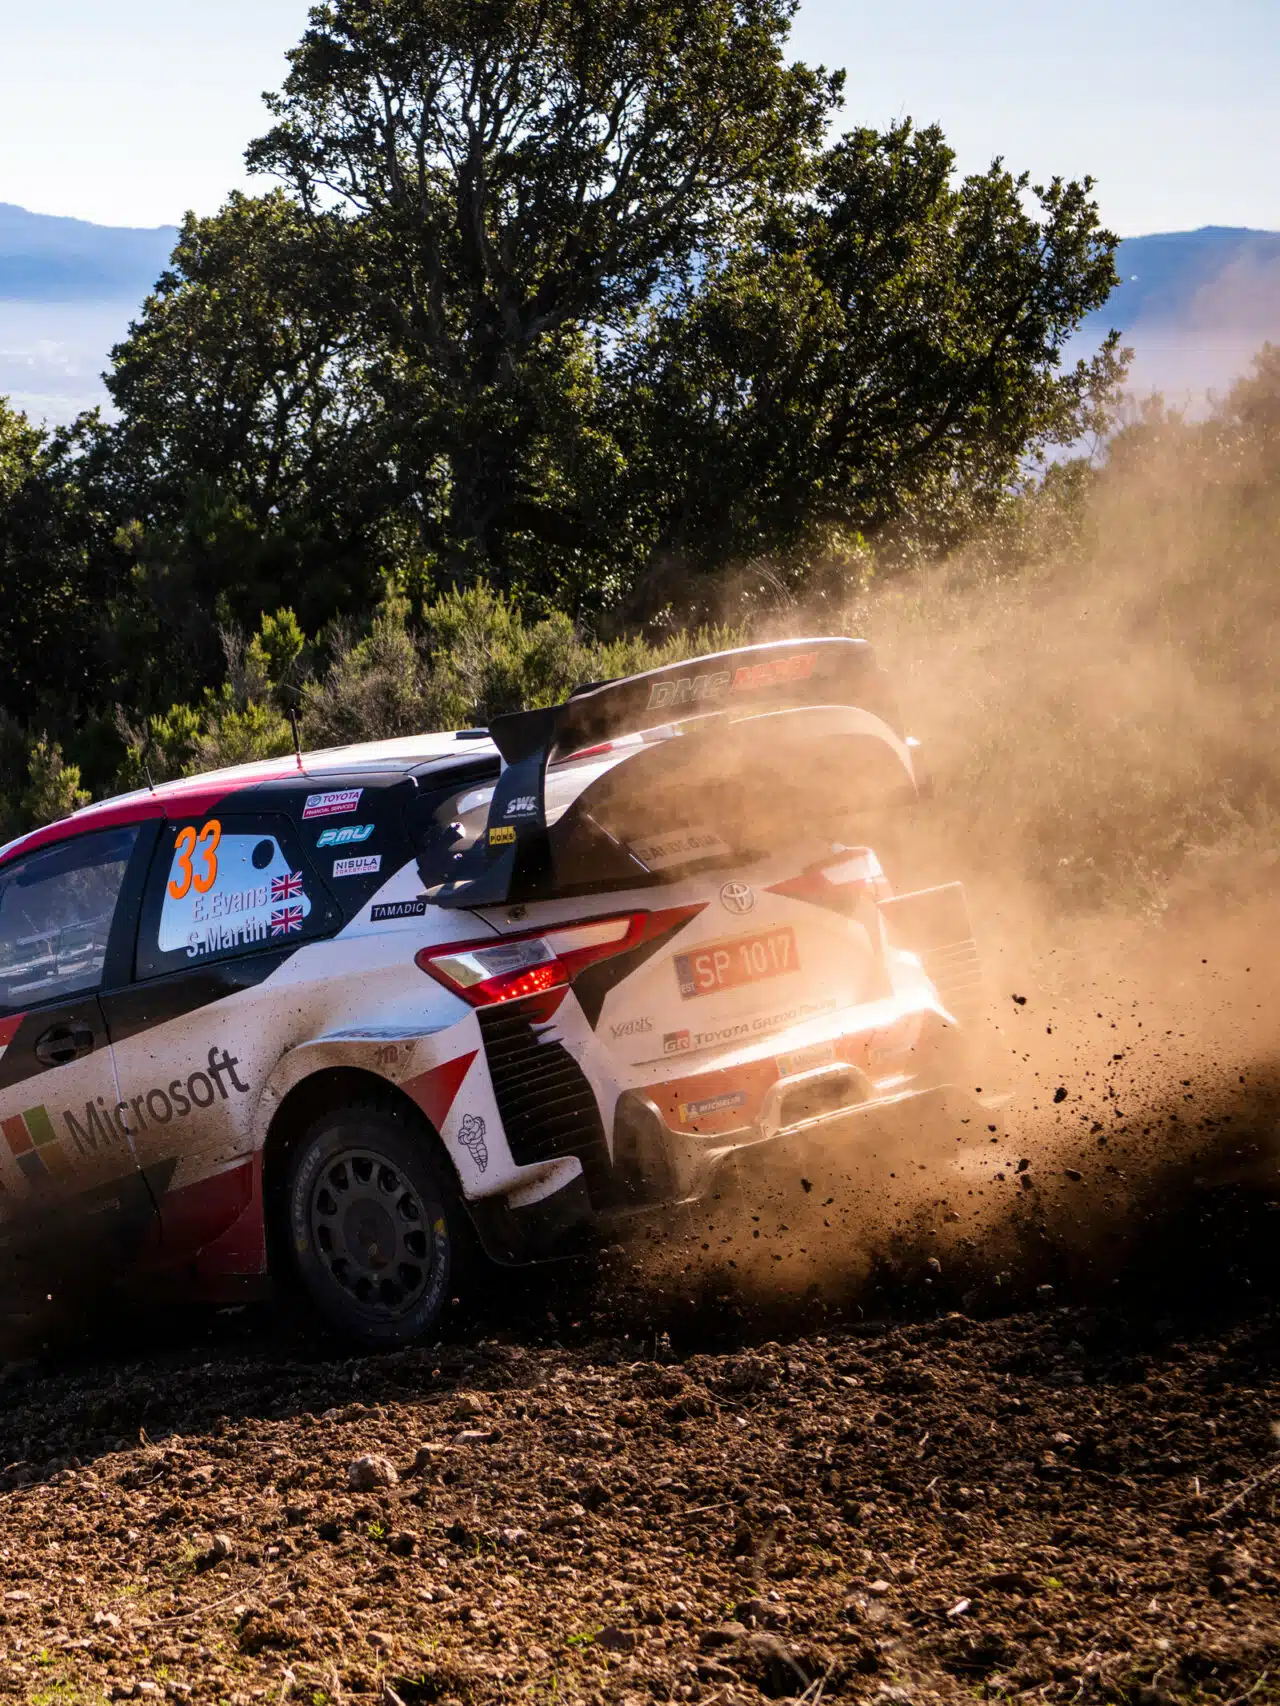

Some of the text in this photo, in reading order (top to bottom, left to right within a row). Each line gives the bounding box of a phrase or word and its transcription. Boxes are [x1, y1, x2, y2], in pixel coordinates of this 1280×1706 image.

[646, 671, 731, 710] DMG
[323, 791, 359, 803] TOYOTA
[491, 833, 514, 842] PONS
[168, 819, 222, 899] 33
[335, 858, 378, 870] NISULA
[193, 886, 268, 922] E.Evans
[373, 902, 425, 917] TAMADIC
[186, 916, 268, 958] S.Martin
[695, 935, 791, 988] SP 1017
[680, 983, 696, 994] EST
[610, 1015, 653, 1039] YARIS
[693, 1023, 749, 1047] TOYOTA
[63, 1046, 251, 1154] Microsoft
